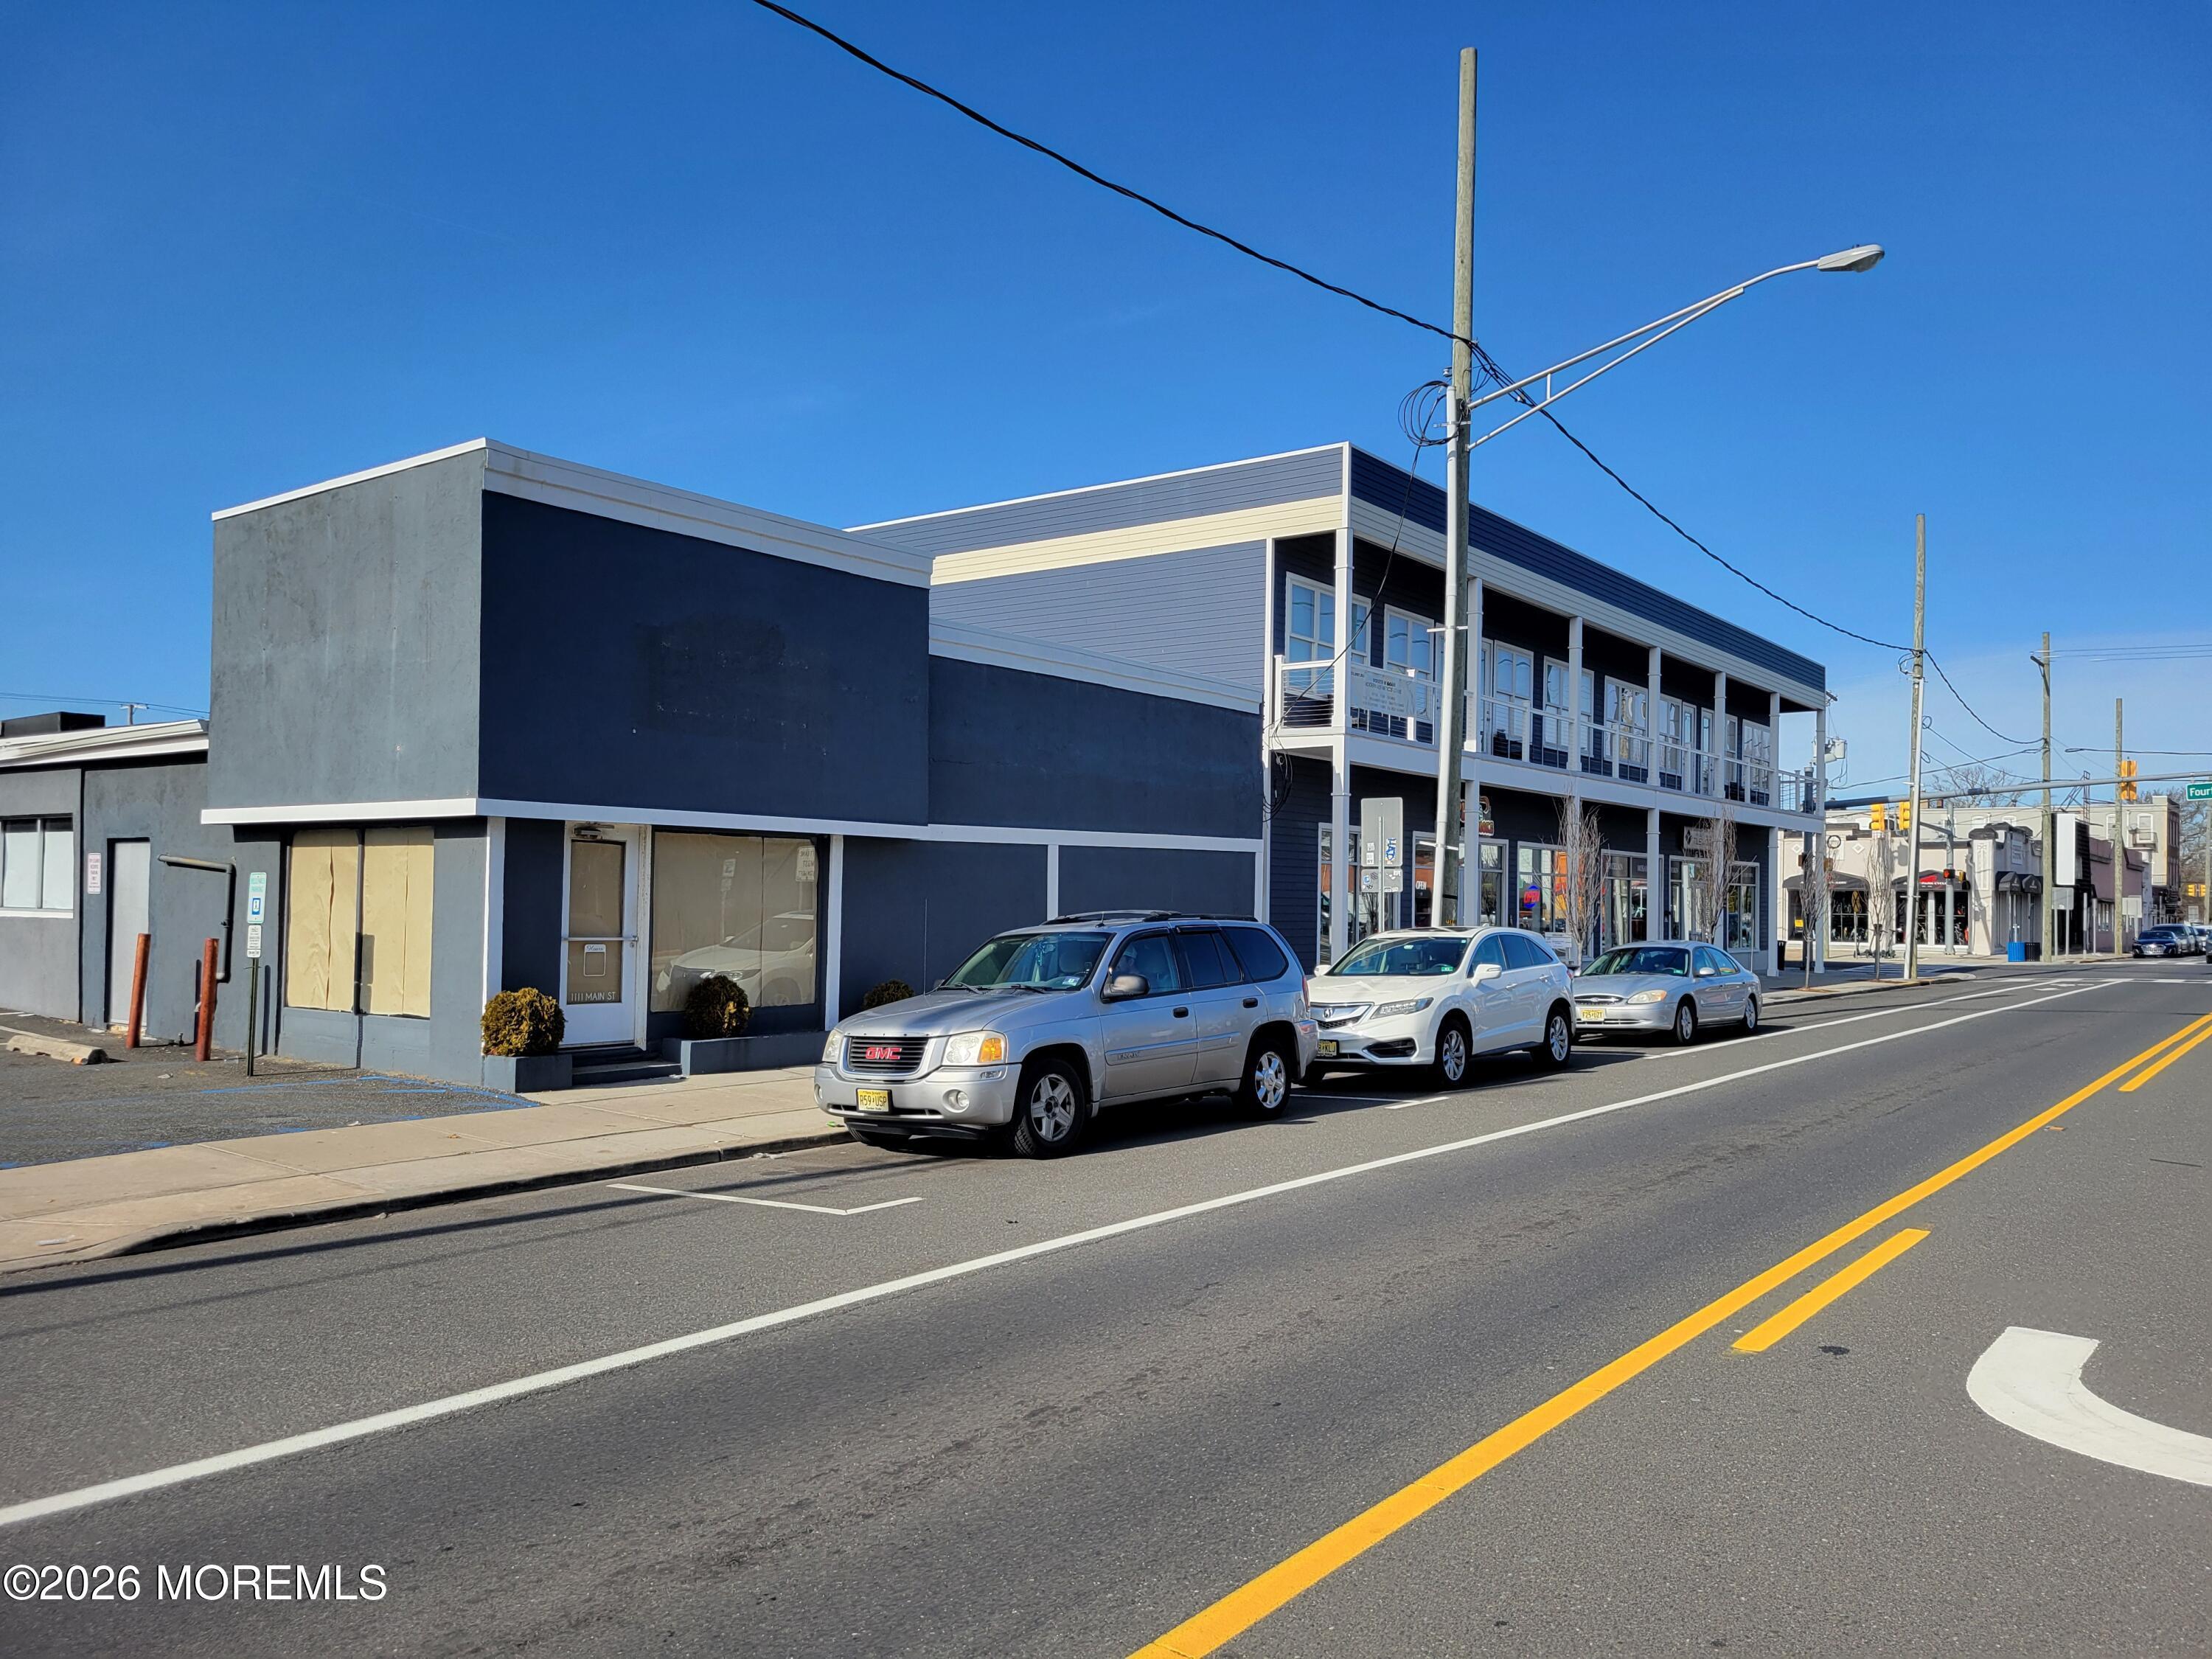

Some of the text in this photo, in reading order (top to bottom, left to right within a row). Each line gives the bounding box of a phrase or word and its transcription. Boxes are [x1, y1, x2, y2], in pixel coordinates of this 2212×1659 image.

[2190, 787, 2212, 796] Four
[1416, 880, 1427, 890] OPEN
[571, 991, 616, 1001] 1111 MAIN ST
[865, 1046, 902, 1060] GMC
